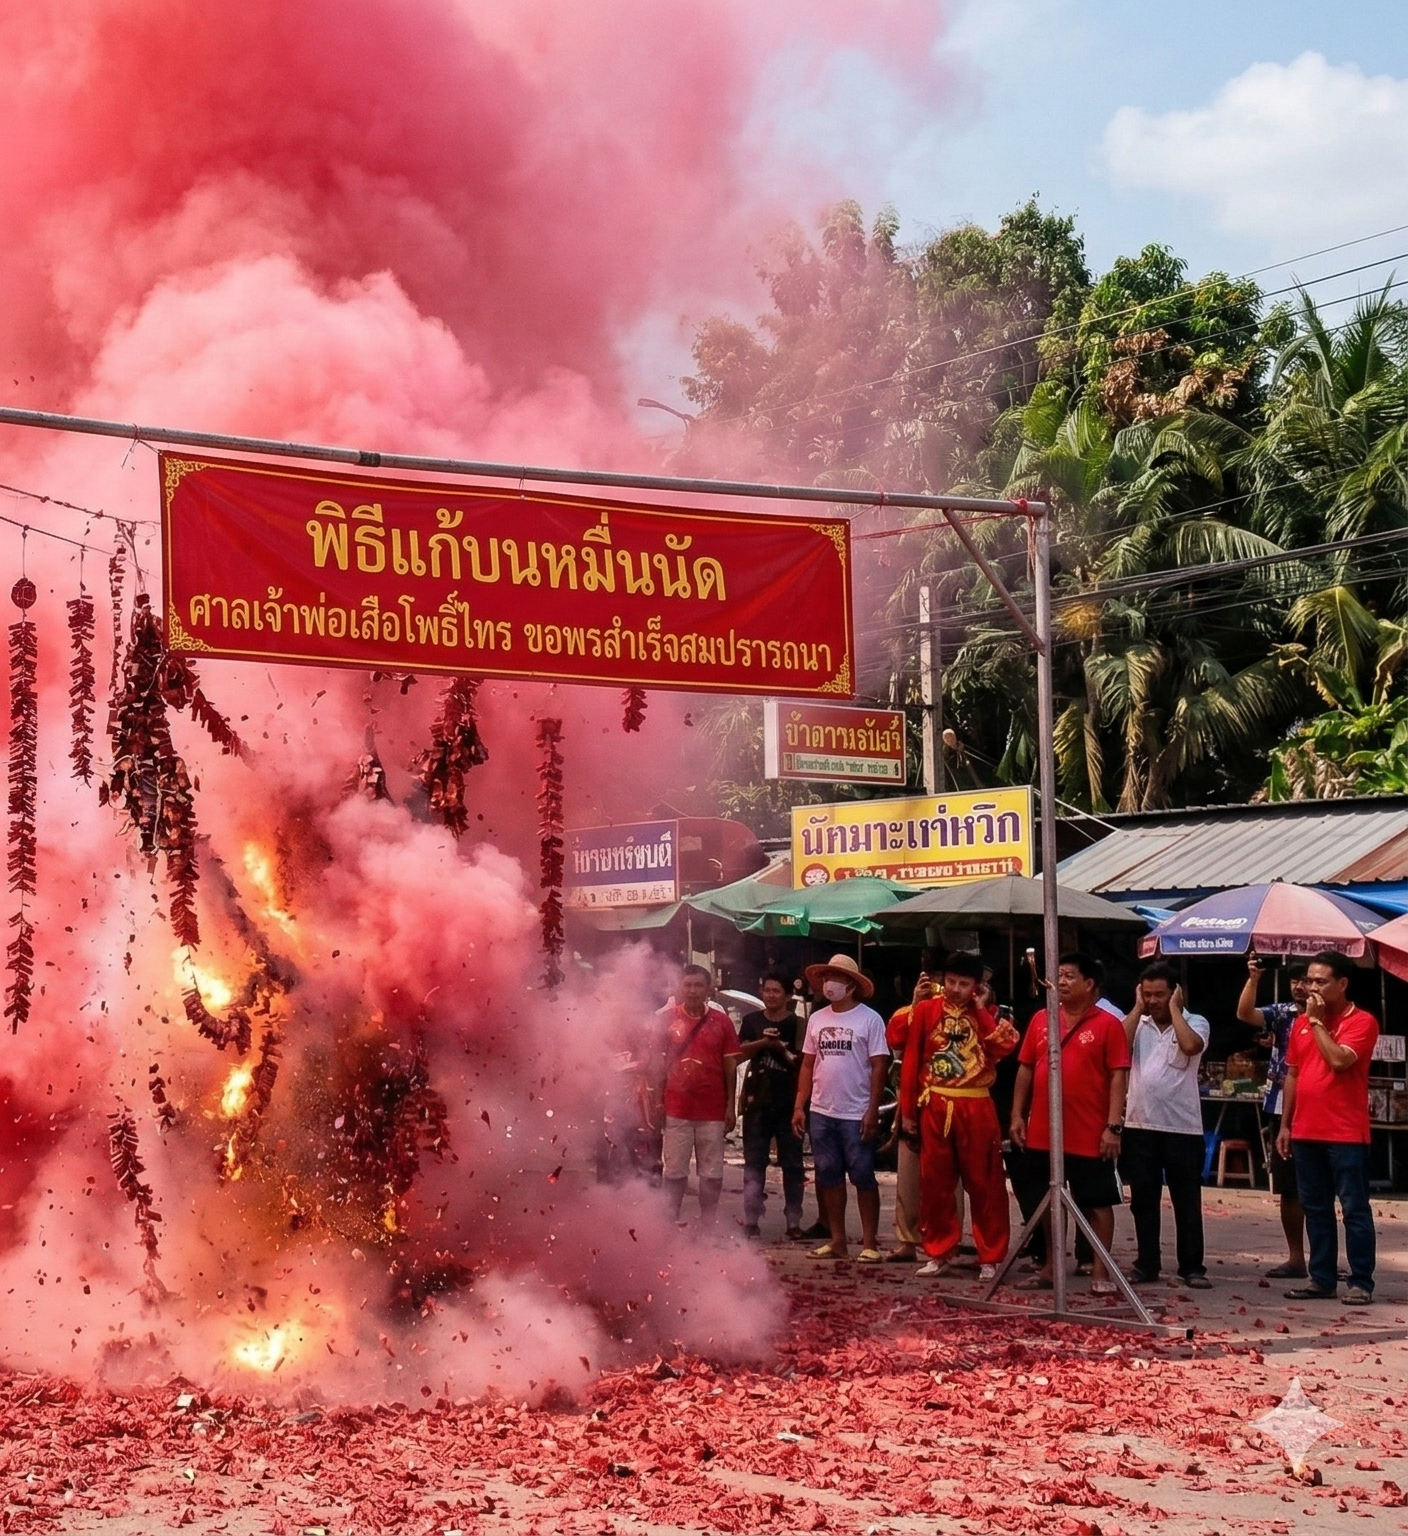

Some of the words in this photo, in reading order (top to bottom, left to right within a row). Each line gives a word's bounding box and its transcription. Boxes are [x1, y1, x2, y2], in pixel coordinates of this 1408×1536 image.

[306, 500, 727, 601] พิธีแก้บนหมื่นนัด
[189, 586, 512, 651] ศาลเจ้าพ่อเสือโพธิ์ไทร
[523, 615, 832, 671] ขอพรสำเร็จสมปรารถนา
